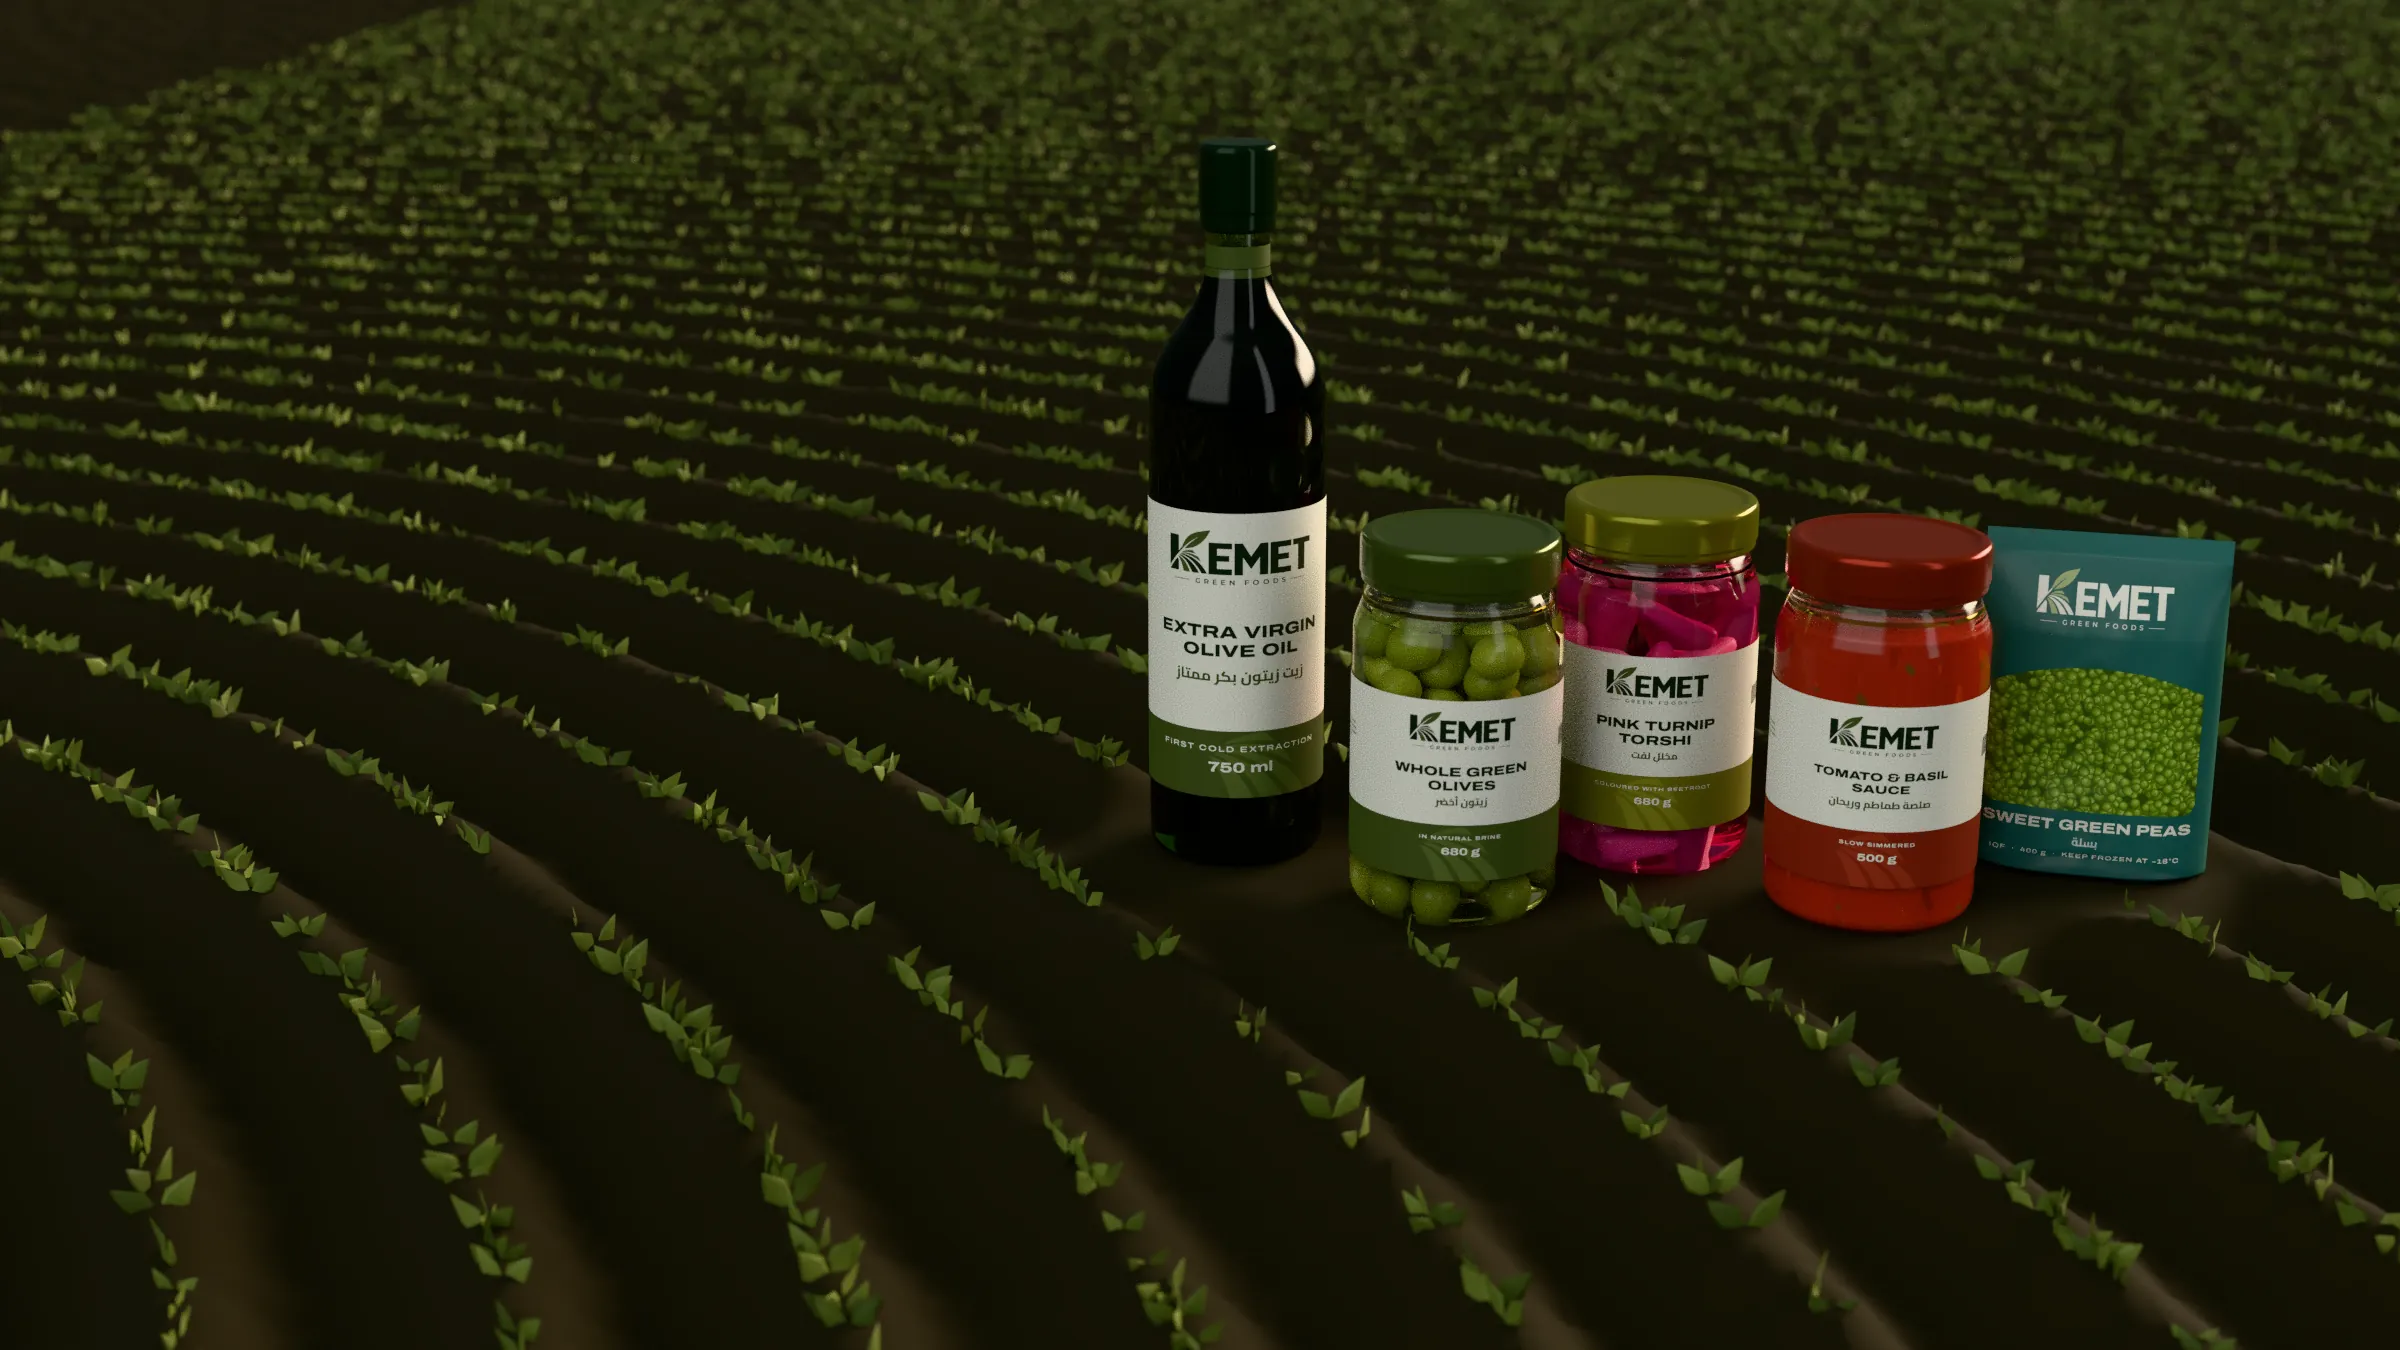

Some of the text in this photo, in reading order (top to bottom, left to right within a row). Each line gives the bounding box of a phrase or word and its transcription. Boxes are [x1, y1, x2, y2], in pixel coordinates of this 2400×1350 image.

[1170, 530, 1310, 576] KEMET
[1195, 576, 1287, 586] GREEN FOODS
[2036, 568, 2176, 622] KEMET
[1163, 614, 1315, 639] EXTRA VIRGIN
[2061, 619, 2145, 632] GREEN FOODS
[1183, 640, 1298, 658] OLIVE OIL
[1176, 664, 1303, 686] زيت زيتون بكر ممتاز
[1606, 666, 1709, 699] KEMET
[1409, 711, 1517, 744] KEMET
[1596, 714, 1716, 732] PINK TURNIP
[1618, 732, 1692, 747] TORSHI
[1829, 716, 1940, 751] KEMET
[1165, 733, 1313, 754] FIRST COLD EXTRACTION
[1850, 749, 1880, 757] GREEN
[1207, 759, 1274, 774] 750 ml
[1395, 760, 1527, 777] WHOLE GREEN
[1813, 762, 1949, 784] TOMATO & BASIL
[1428, 780, 1496, 791] OLIVES
[1595, 779, 1711, 793] COLOURED WITH BEETROOT
[1851, 782, 1912, 796] SAUCE
[1633, 796, 1673, 810] 680 g
[1862, 801, 1901, 812] طماطم
[1982, 806, 2191, 837] SWEET GREEN PEAS
[1430, 834, 1473, 842] NATURAL
[1475, 833, 1502, 841] BRINE
[1838, 838, 1916, 849] SLOW SIMMERED
[2071, 836, 2098, 850] بسلة
[1440, 847, 1482, 859] 680 g
[1856, 852, 1898, 866] 500 g
[1989, 840, 2006, 849] IQF
[2019, 846, 2038, 855] 400
[2061, 852, 2088, 860] KEEP
[2091, 854, 2133, 863] FROZEN
